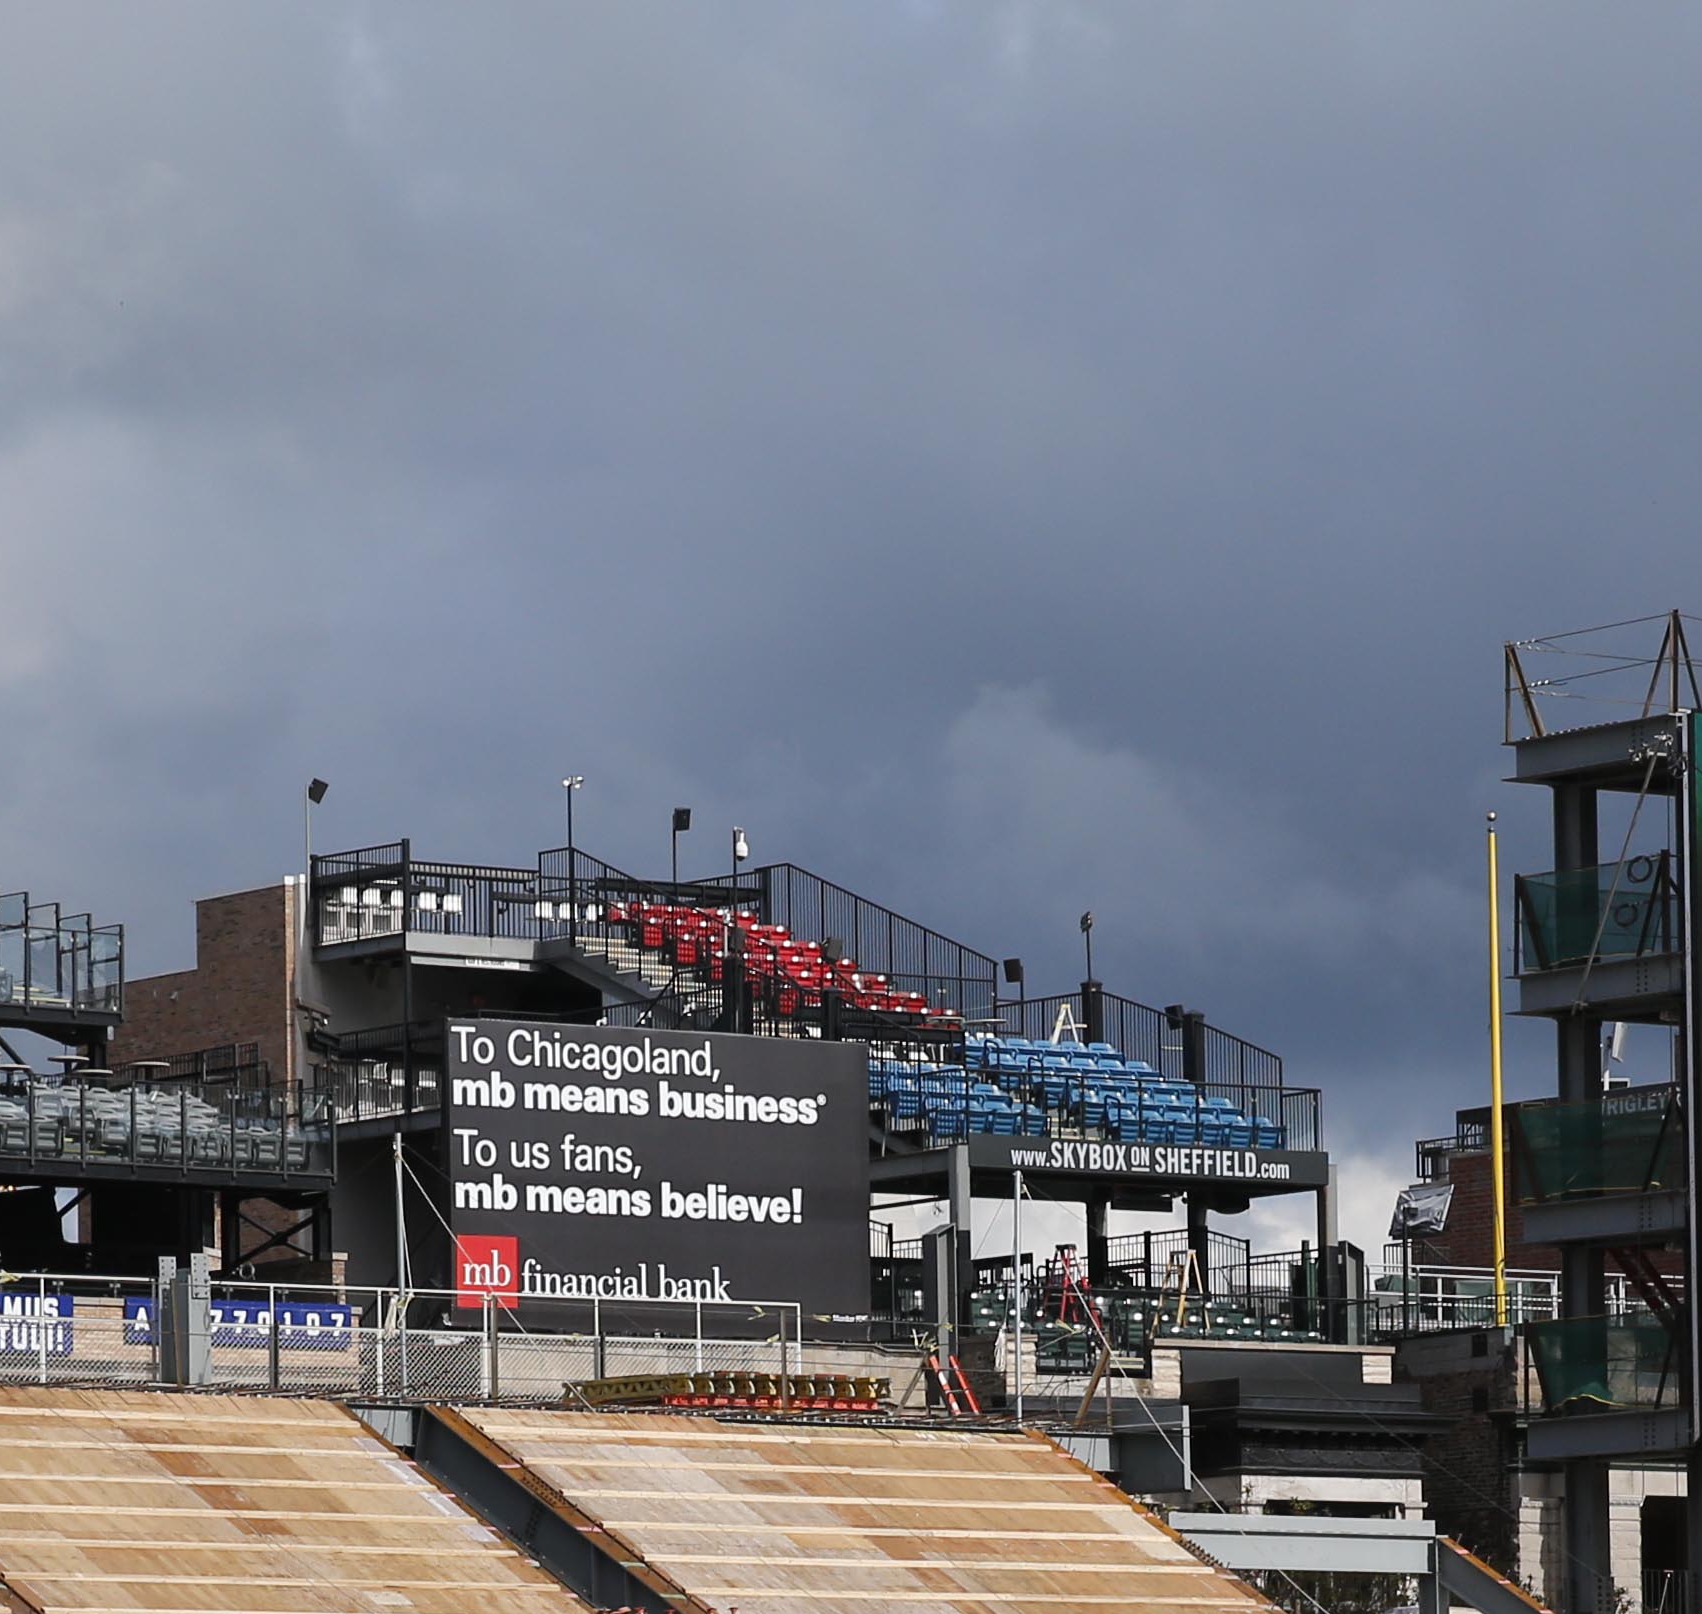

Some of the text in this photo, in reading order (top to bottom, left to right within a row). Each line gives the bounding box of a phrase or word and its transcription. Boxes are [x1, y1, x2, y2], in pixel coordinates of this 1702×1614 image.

[451, 1025, 721, 1082] To Chicagoland,
[453, 1071, 514, 1108] mb
[525, 1085, 648, 1116] means
[454, 1128, 641, 1179] To us fans,
[1131, 1150, 1149, 1171] ON
[1154, 1148, 1290, 1180] SHEFFIELD.com
[455, 1175, 801, 1224] mb means believe!
[463, 1250, 730, 1301] mb financial bank
